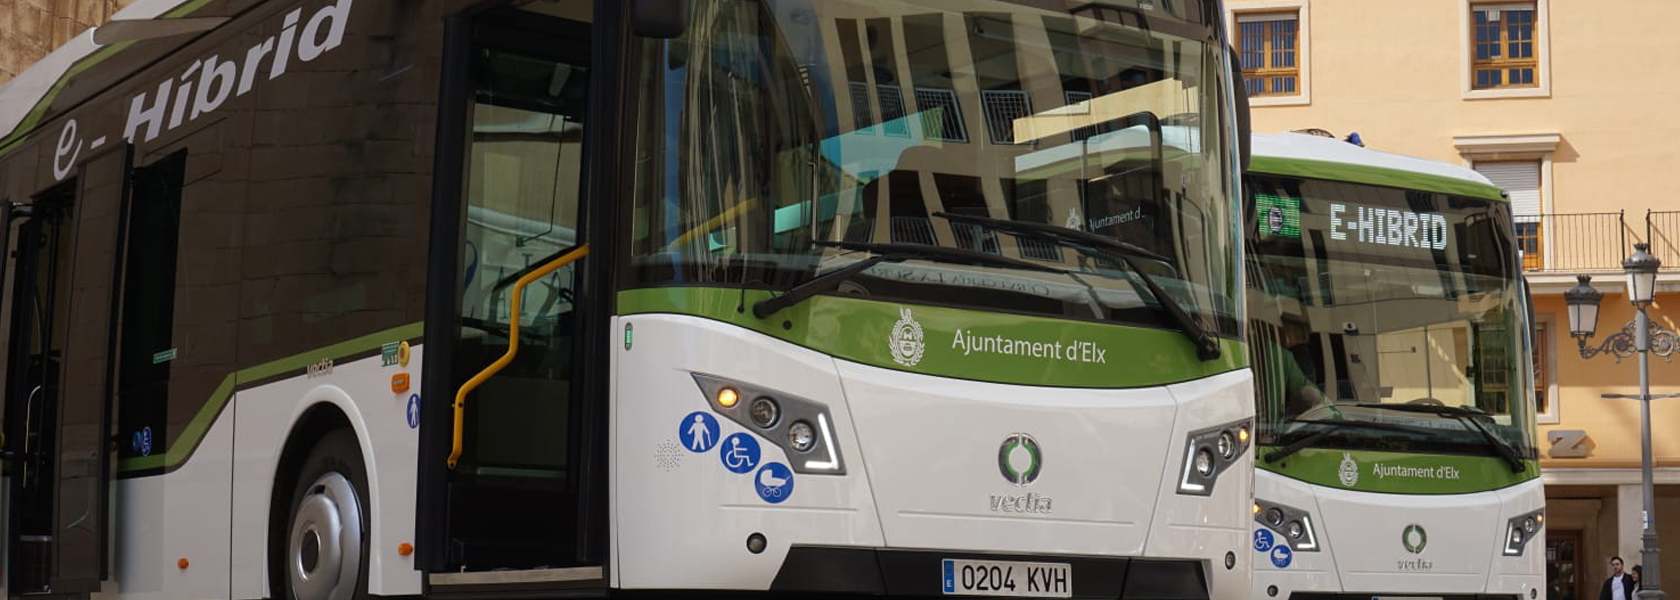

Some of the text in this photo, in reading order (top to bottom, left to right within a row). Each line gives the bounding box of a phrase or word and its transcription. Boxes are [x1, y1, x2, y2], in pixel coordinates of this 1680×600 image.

[122, 0, 354, 144] Híbrid
[1330, 203, 1447, 250] E-HIBRID
[952, 329, 1062, 359] Ajuntament
[1373, 463, 1434, 479] Ajuntament
[962, 564, 1016, 592] 0204
[1027, 566, 1068, 593] KVH
